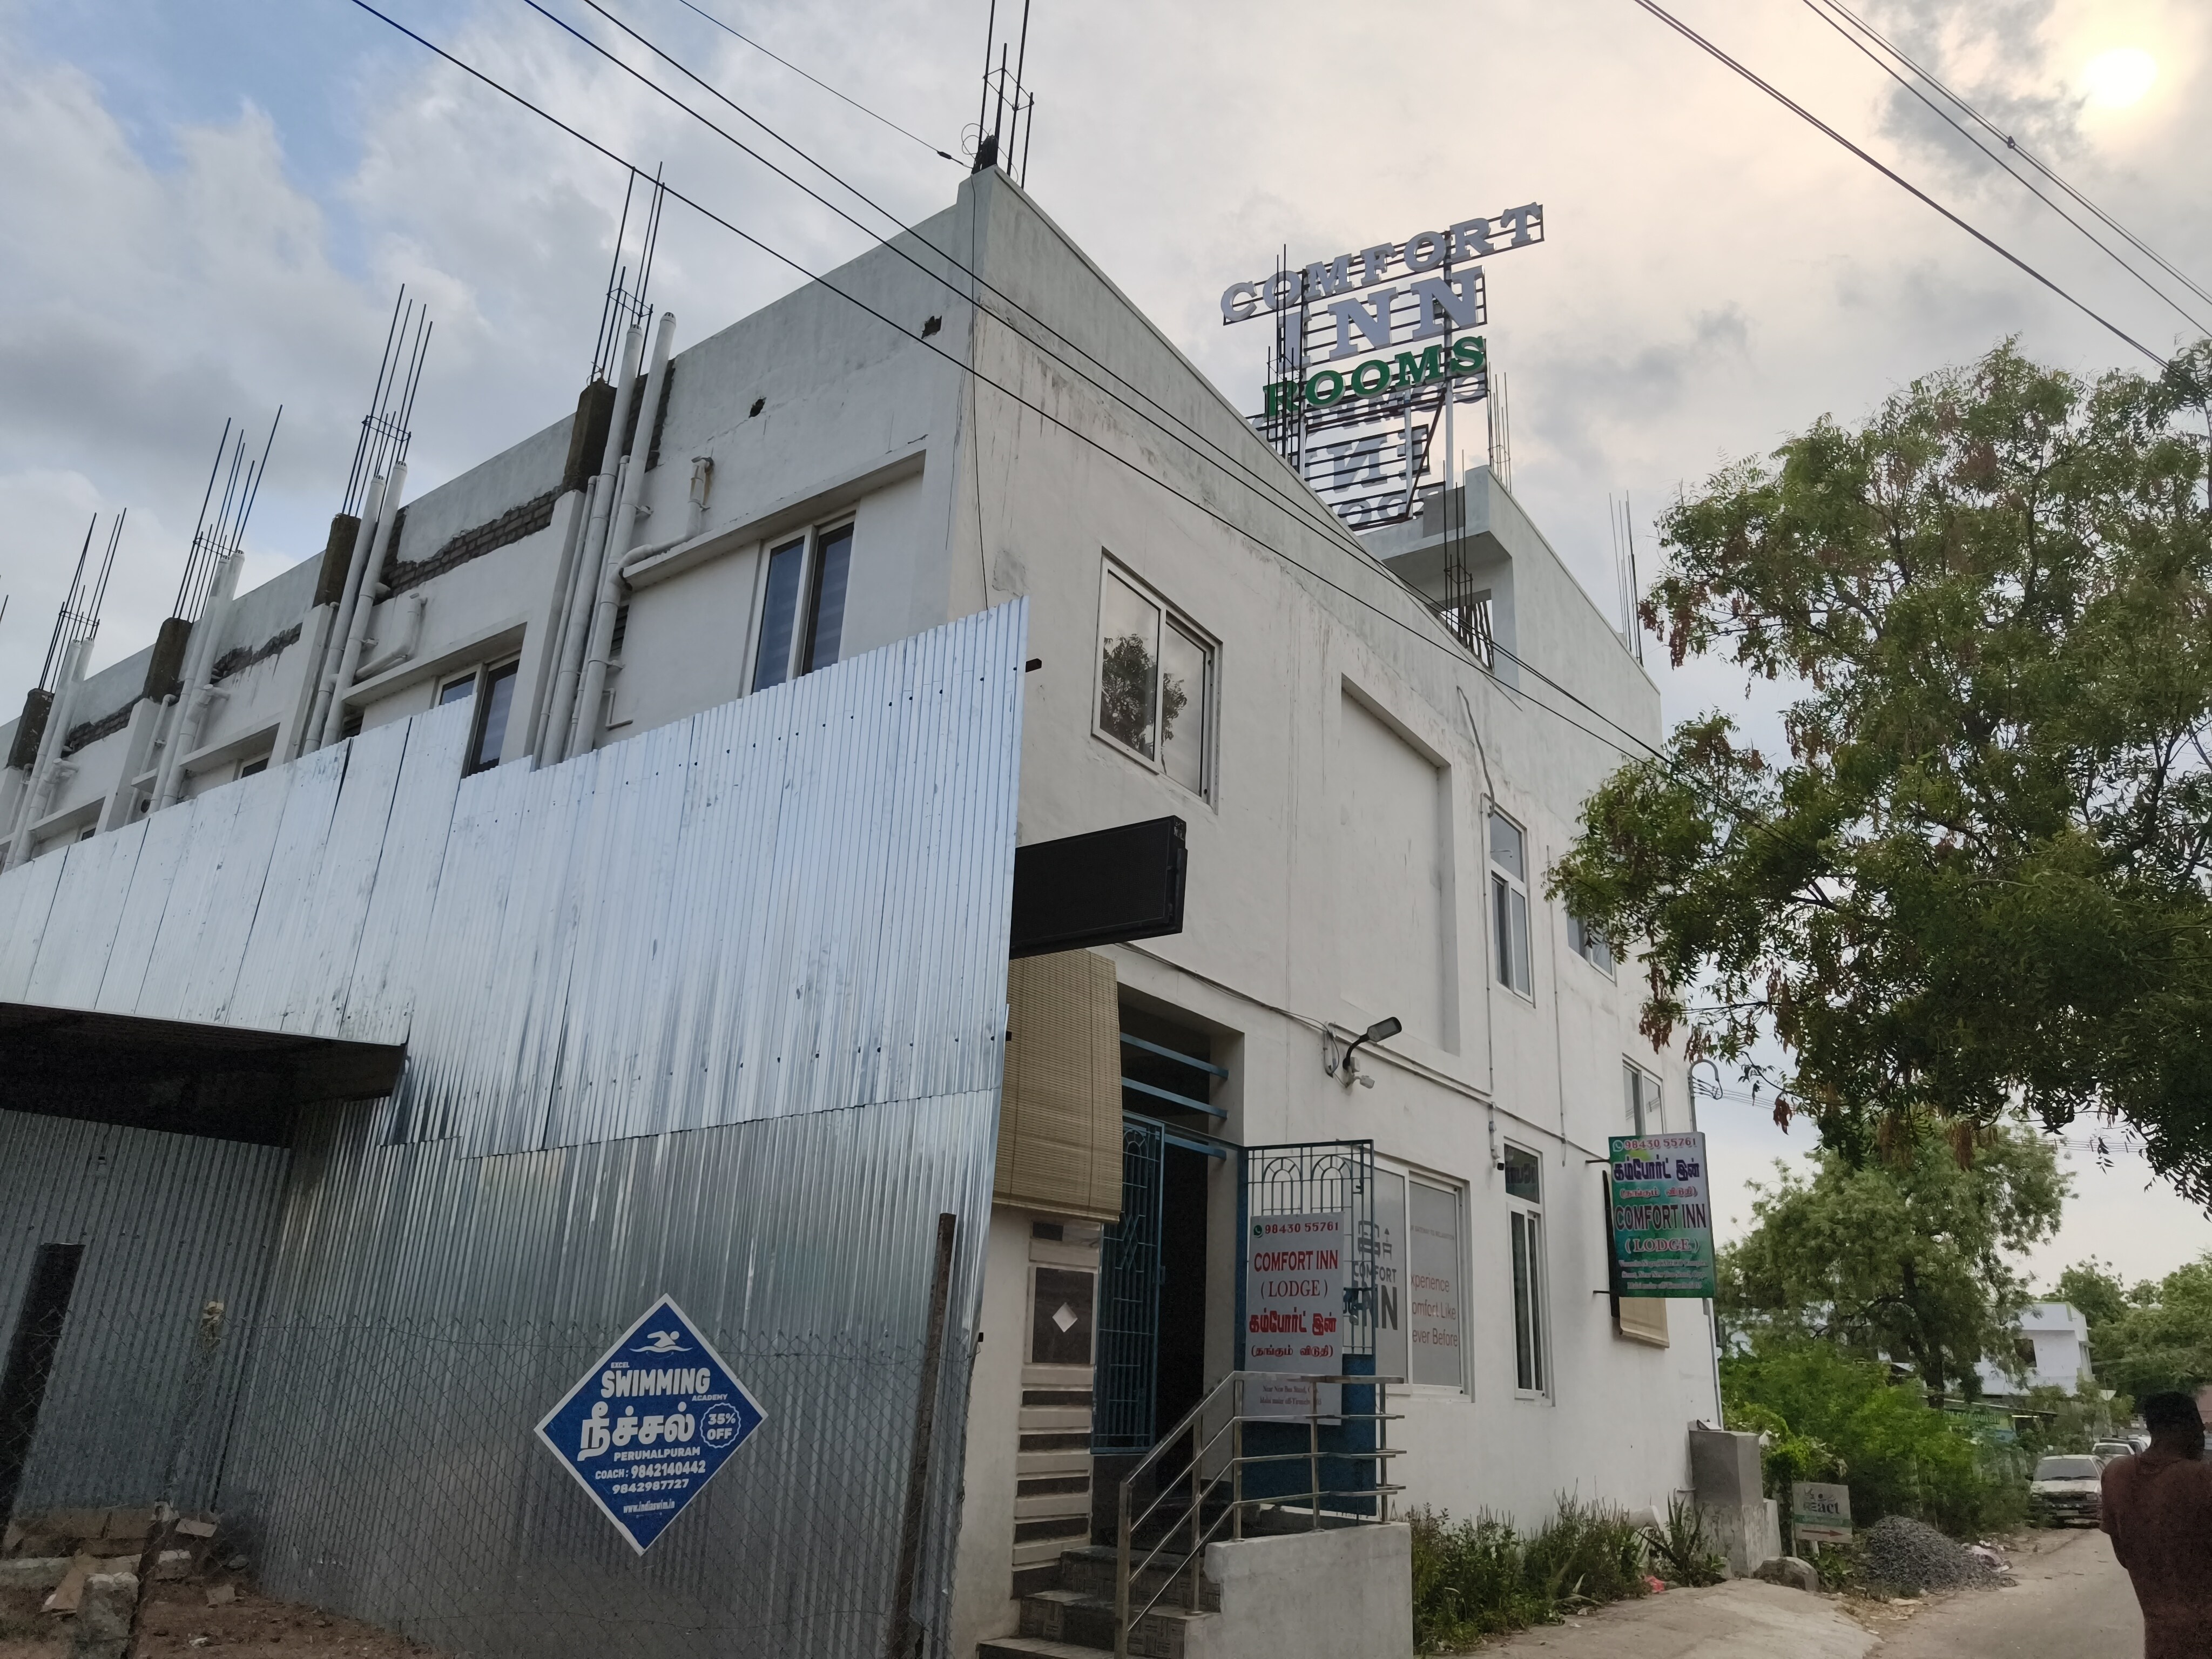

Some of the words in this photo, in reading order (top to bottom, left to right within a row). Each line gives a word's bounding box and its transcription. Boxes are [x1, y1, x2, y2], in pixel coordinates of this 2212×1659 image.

[1220, 202, 1542, 321] COMFORT
[1278, 265, 1485, 374] INN
[1263, 336, 1487, 418] ROOMS
[1625, 1139, 1660, 1150] 98430
[1663, 1137, 1696, 1148] 55761
[1676, 1158, 1700, 1181] இன்
[1615, 1204, 1678, 1230] COMFORT
[1682, 1203, 1707, 1229] INN
[1265, 1223, 1301, 1234] 98430
[1304, 1222, 1339, 1232] 55761
[1254, 1251, 1313, 1272] COMFORT
[1316, 1250, 1338, 1270] INN
[1411, 1272, 1449, 1292] xperience
[1412, 1299, 1439, 1318] omfort
[1441, 1301, 1456, 1320] Like
[1312, 1312, 1337, 1336] இன்
[1412, 1329, 1430, 1344] ever
[1432, 1327, 1458, 1347] Before
[601, 1368, 711, 1398] SWIMMING
[707, 1413, 736, 1425] 35%
[577, 1401, 696, 1461] நீச்சல்
[707, 1428, 732, 1440] OFF
[613, 1446, 700, 1461] PERUMALPURAM
[631, 1460, 706, 1479] 9842140442
[612, 1479, 689, 1494] 9842987727
